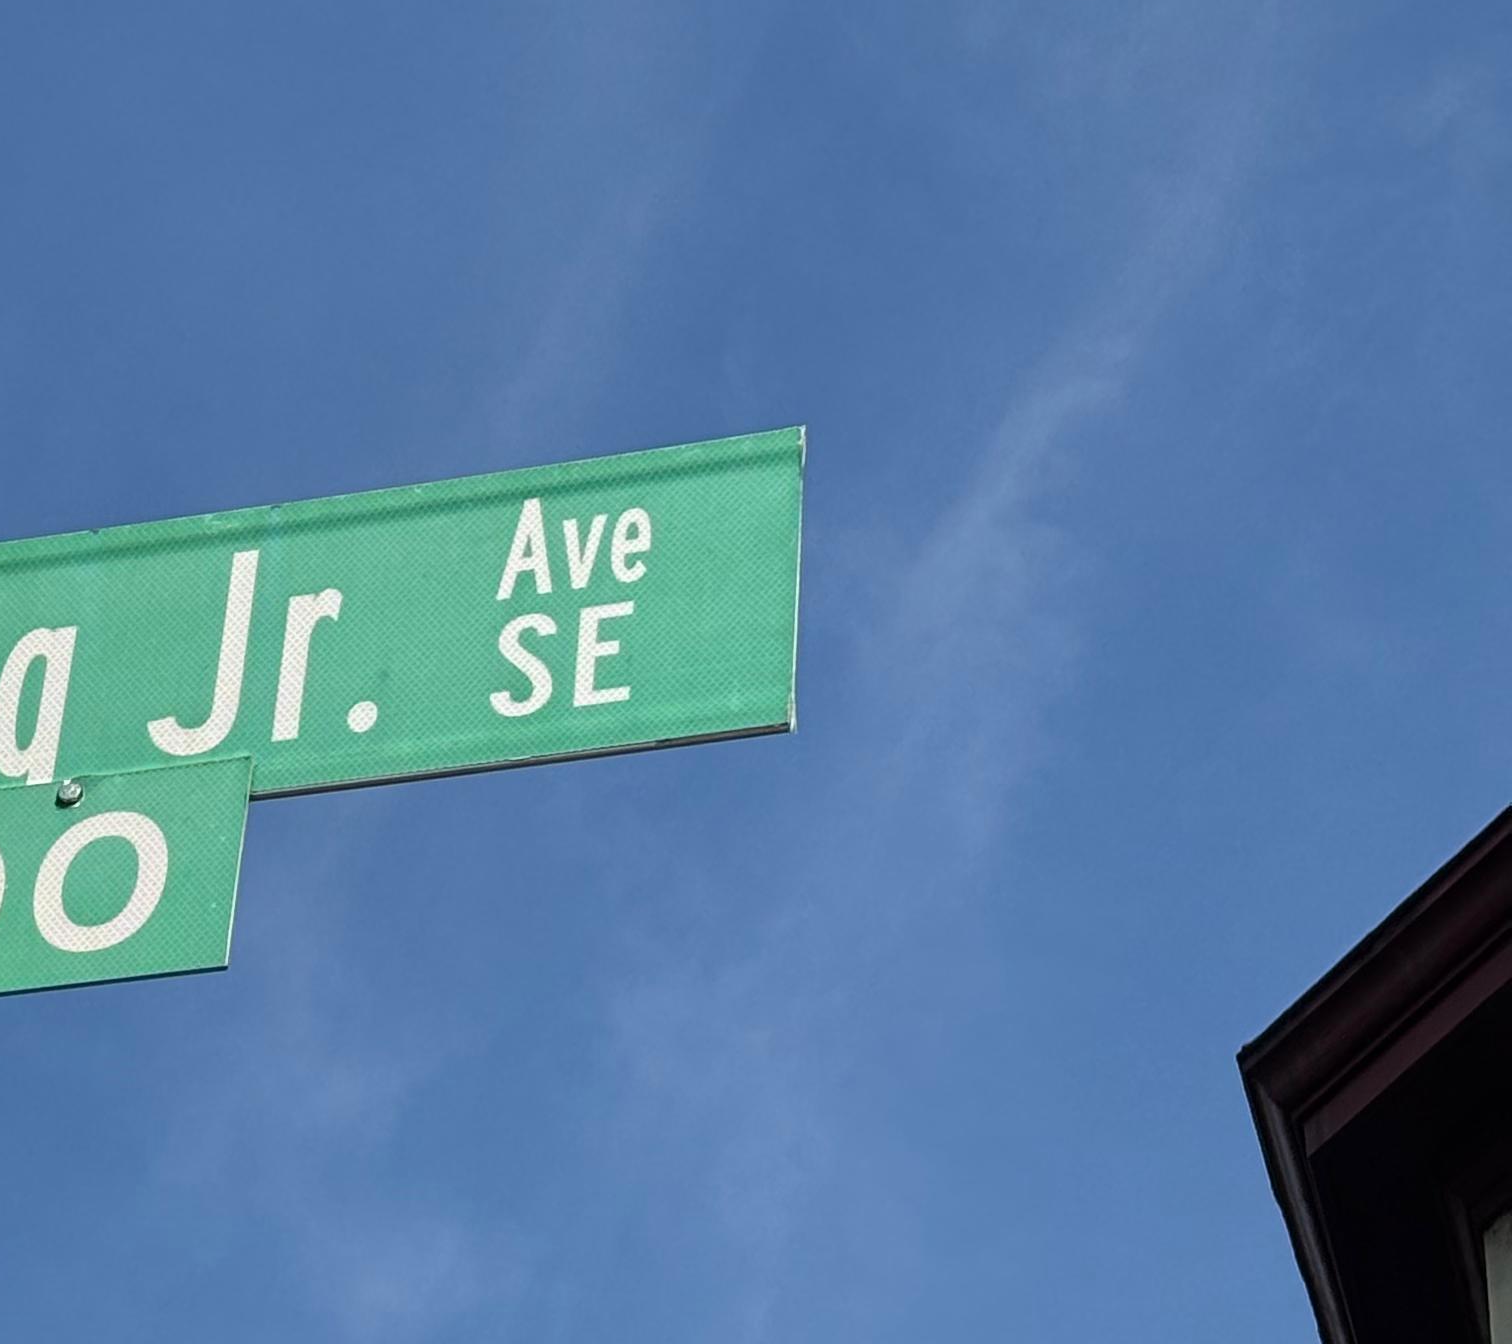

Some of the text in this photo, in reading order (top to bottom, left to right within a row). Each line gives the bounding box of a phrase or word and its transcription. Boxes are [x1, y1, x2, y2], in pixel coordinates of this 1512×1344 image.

[496, 498, 652, 600] Ave
[147, 550, 379, 757] Jr.
[489, 601, 636, 718] SE
